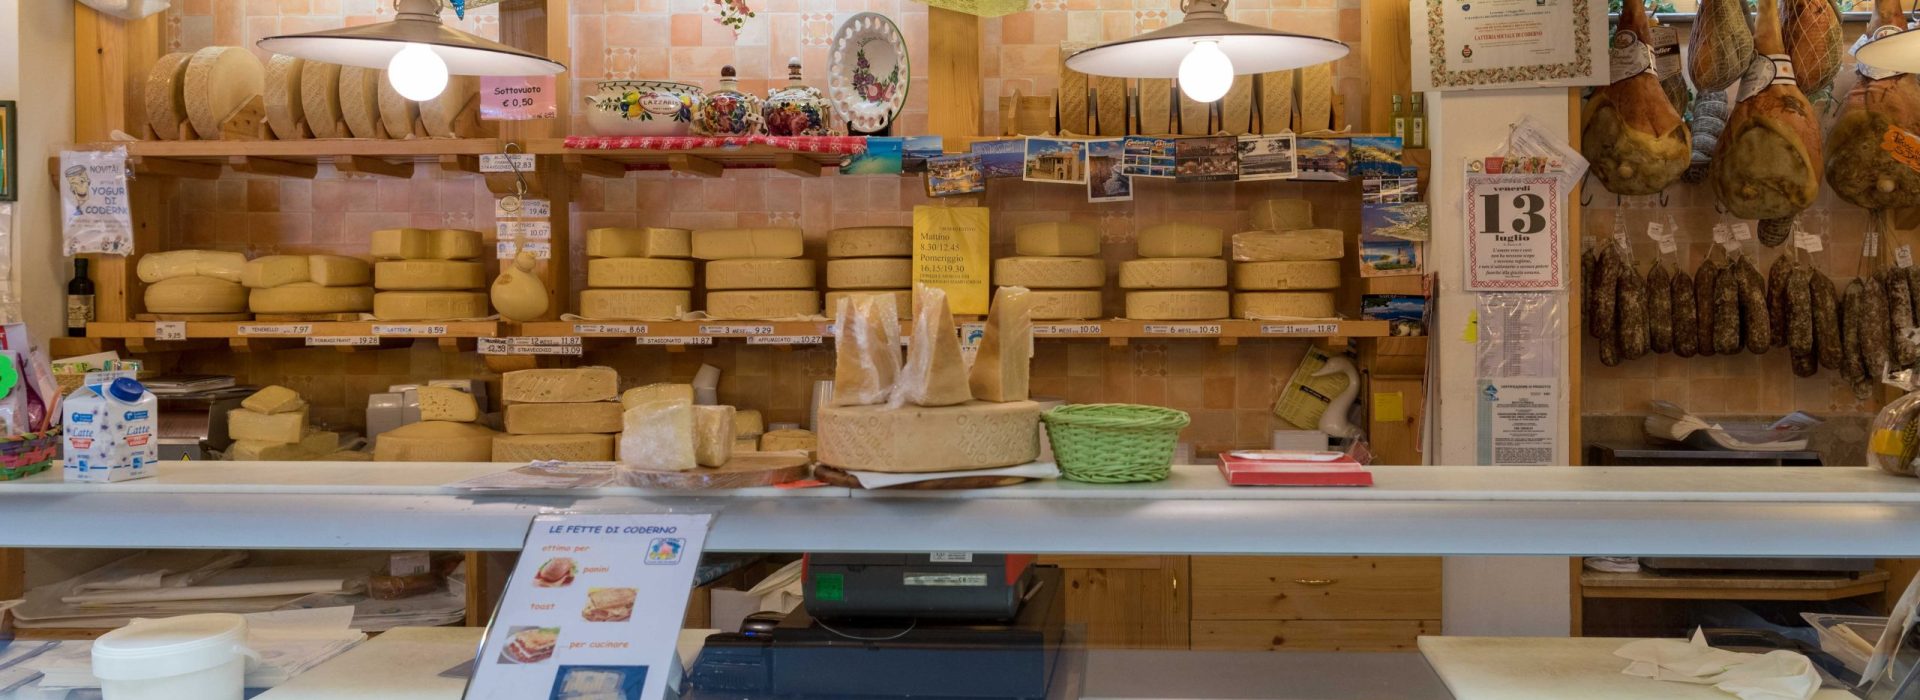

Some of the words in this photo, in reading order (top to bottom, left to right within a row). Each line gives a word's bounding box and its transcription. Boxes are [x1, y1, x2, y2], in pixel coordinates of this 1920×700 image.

[494, 86, 542, 95] Sottovuoto
[502, 99, 509, 107] €
[512, 98, 534, 107] 0,50
[91, 187, 124, 195] YOGUR
[105, 197, 116, 205] DI
[1480, 193, 1547, 235] 13
[920, 232, 950, 241] Mattino
[1495, 234, 1530, 242] luglio
[920, 253, 964, 264] Pomeriggio
[1051, 325, 1056, 333] 5
[73, 427, 94, 437] Latte
[127, 425, 150, 435] Latte
[549, 526, 562, 534] LE
[566, 526, 603, 534] FETTE
[605, 526, 620, 534] DI
[624, 526, 677, 534] CODERNO
[582, 566, 610, 574] panini
